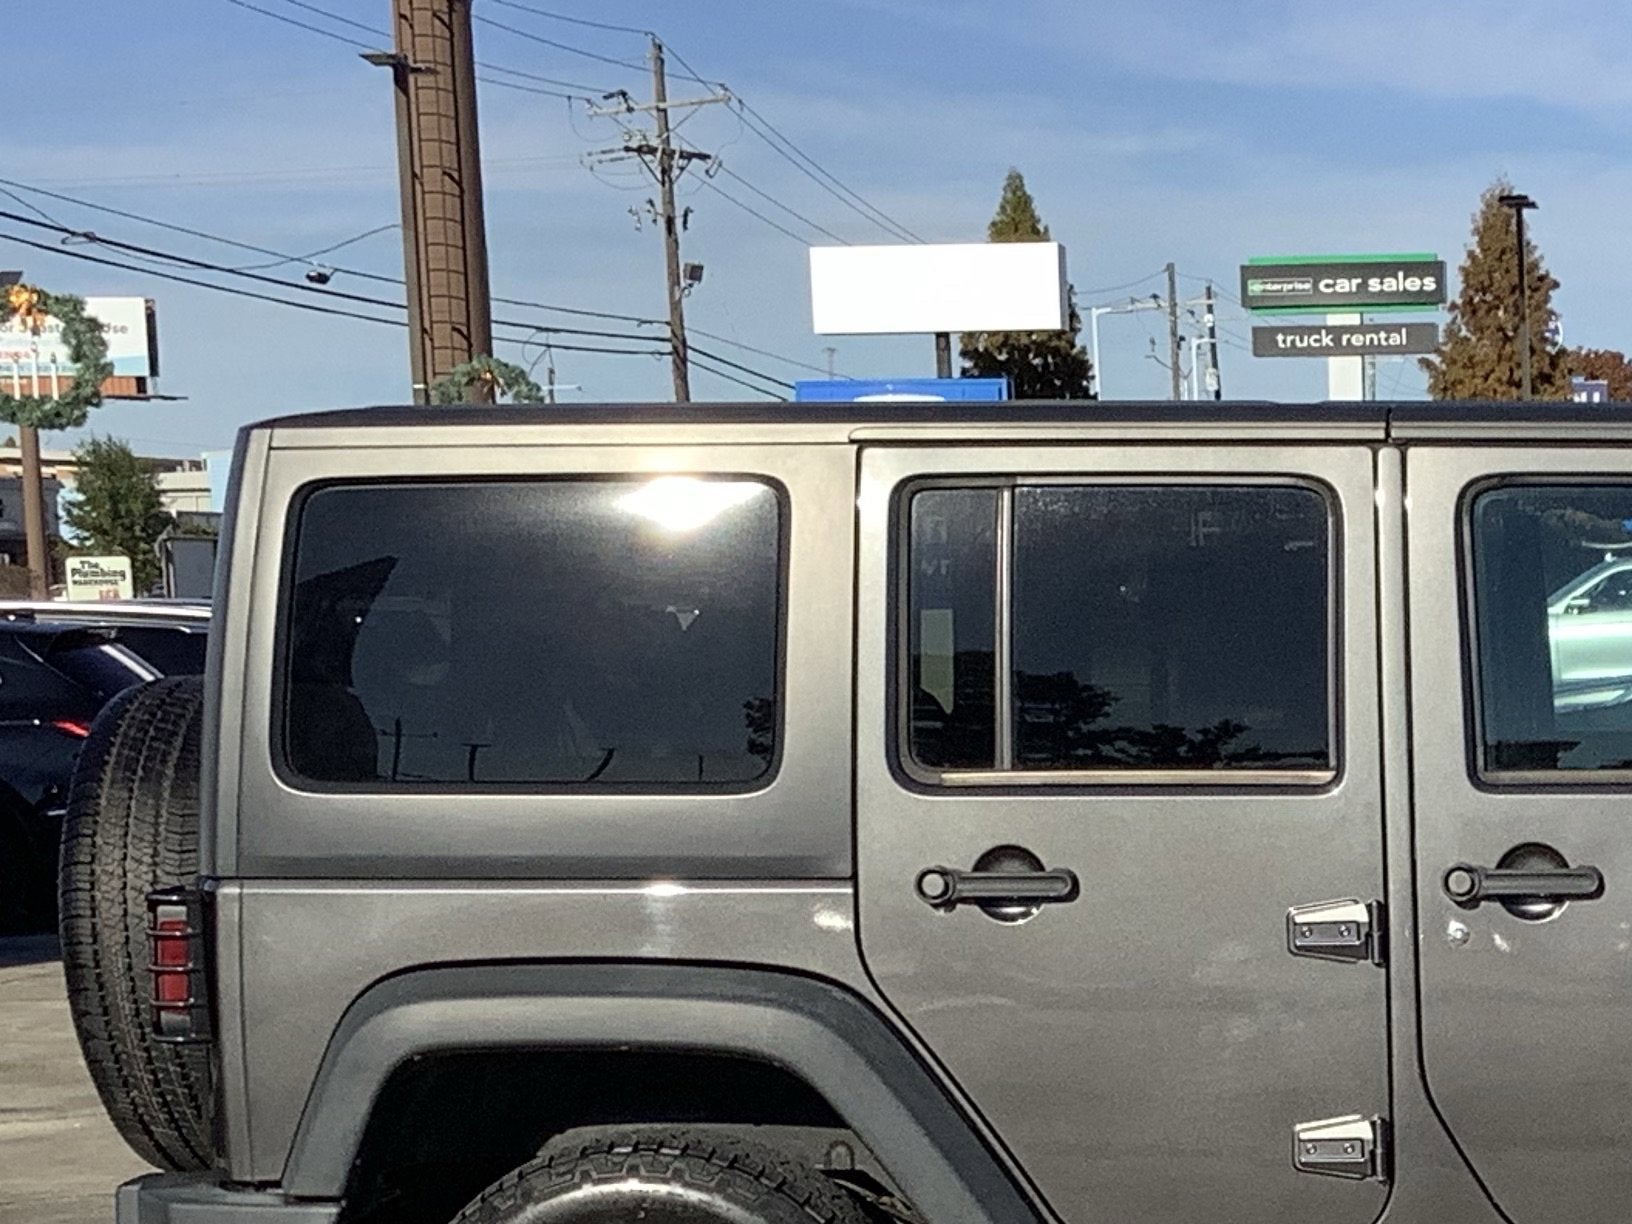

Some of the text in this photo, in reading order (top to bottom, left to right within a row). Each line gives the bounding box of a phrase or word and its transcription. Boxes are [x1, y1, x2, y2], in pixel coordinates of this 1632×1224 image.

[1319, 277, 1363, 293] car
[1367, 271, 1437, 292] sales
[1276, 327, 1407, 348] truck rental
